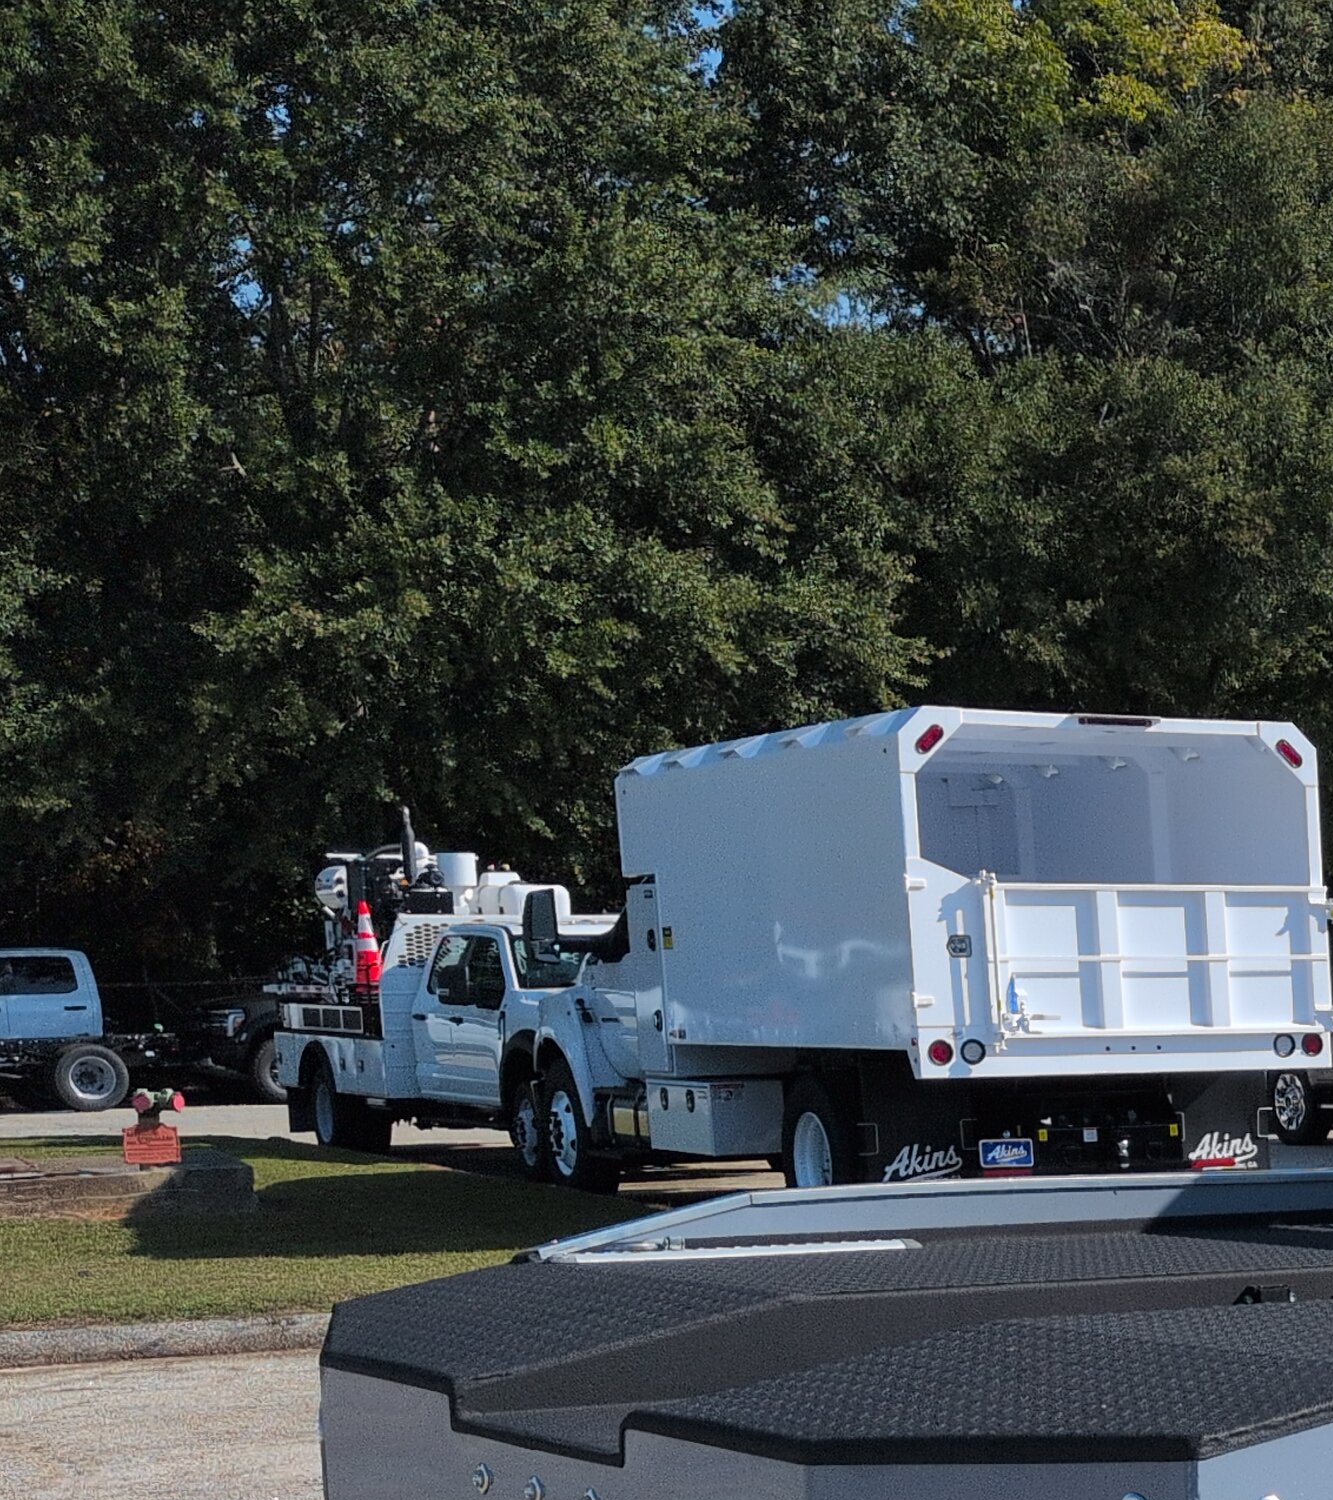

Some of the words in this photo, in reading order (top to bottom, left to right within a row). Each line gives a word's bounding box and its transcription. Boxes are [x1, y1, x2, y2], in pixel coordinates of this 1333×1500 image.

[986, 1143, 1027, 1162] Akins
[1188, 1131, 1258, 1161] Akins
[882, 1143, 962, 1182] Akins
